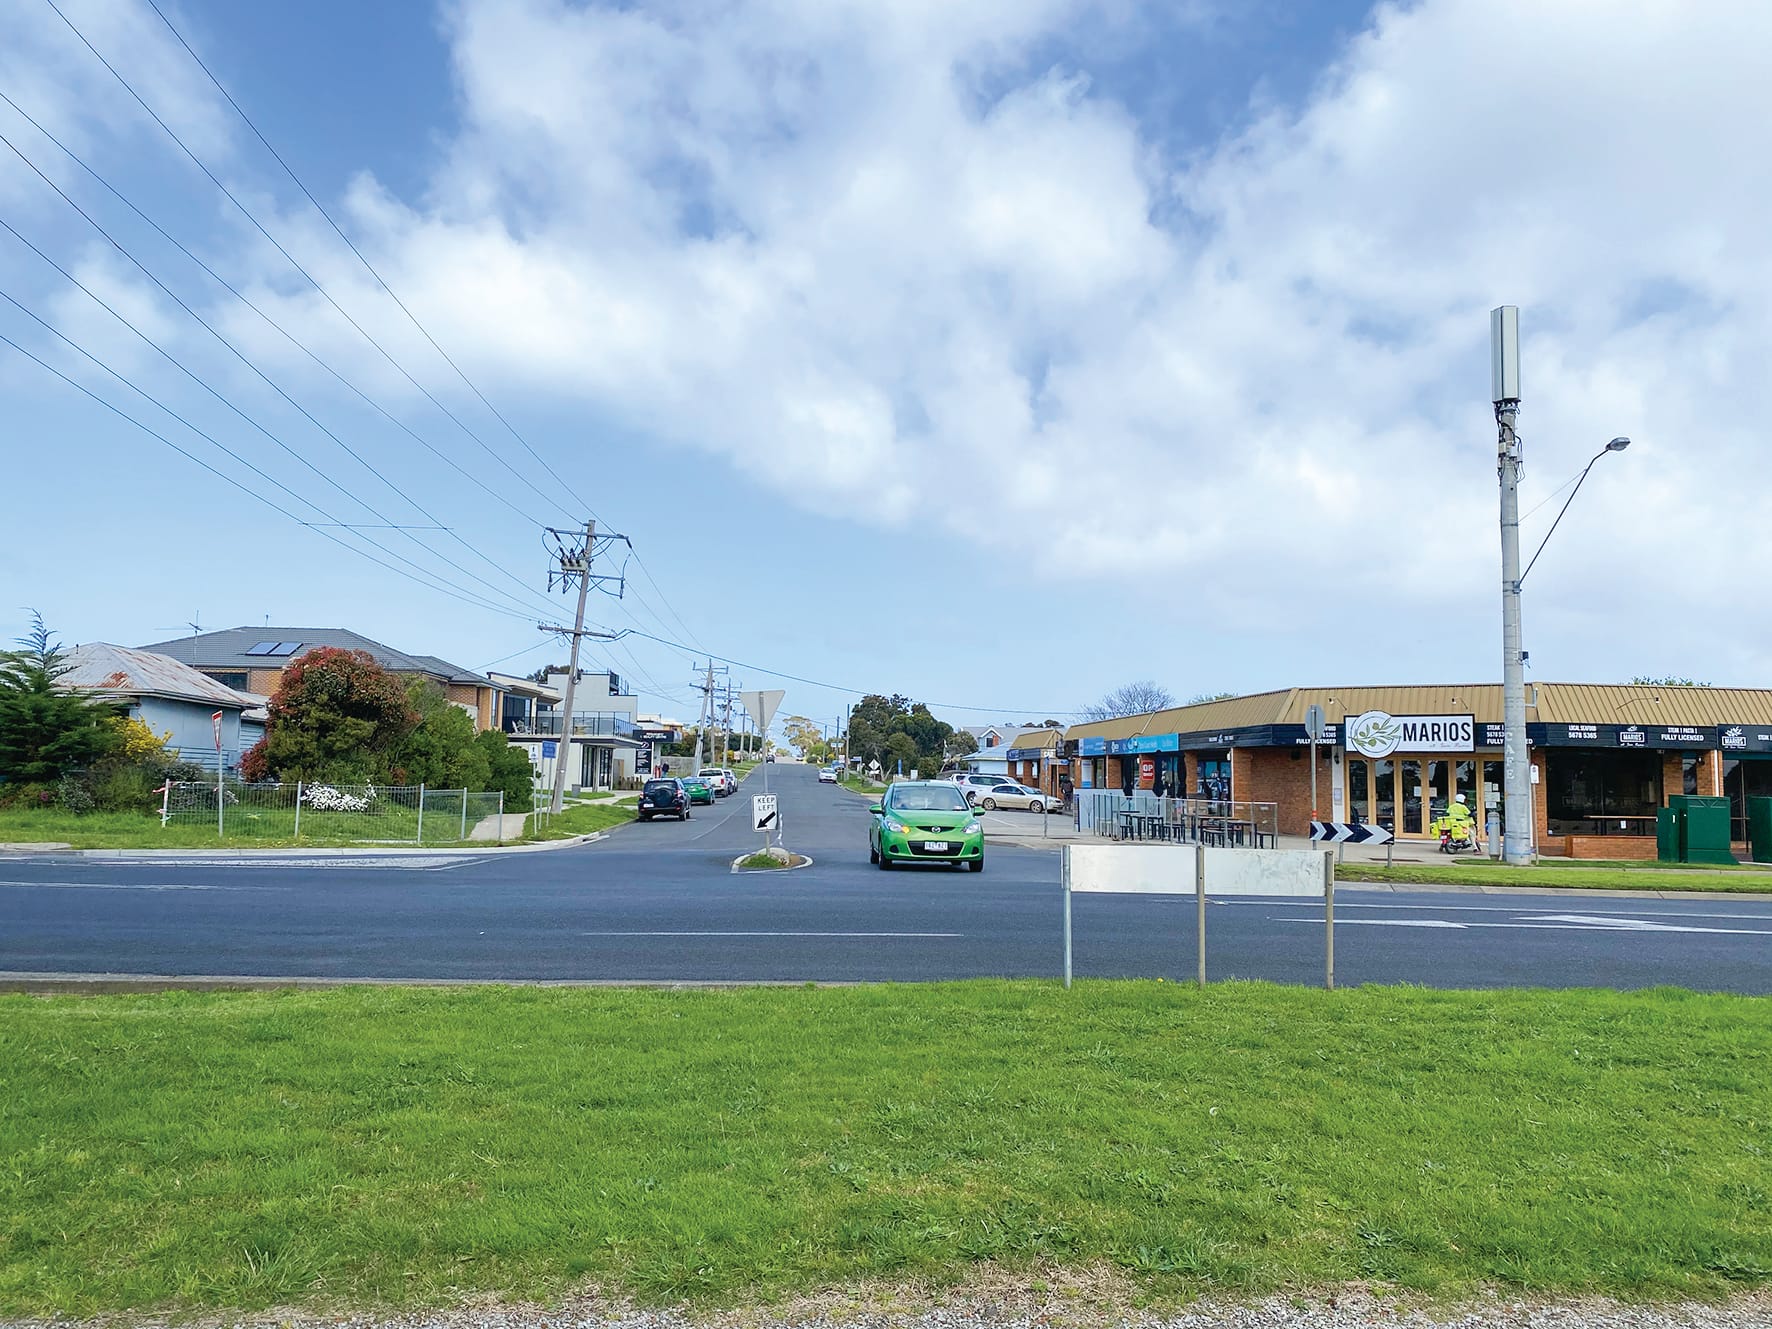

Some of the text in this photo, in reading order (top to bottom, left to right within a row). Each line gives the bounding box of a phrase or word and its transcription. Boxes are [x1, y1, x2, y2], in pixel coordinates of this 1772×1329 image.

[1402, 722, 1471, 742] MARIOS
[1622, 733, 1642, 741] MARIOS
[1678, 734, 1704, 742] LICENSED
[1142, 764, 1153, 772] OP
